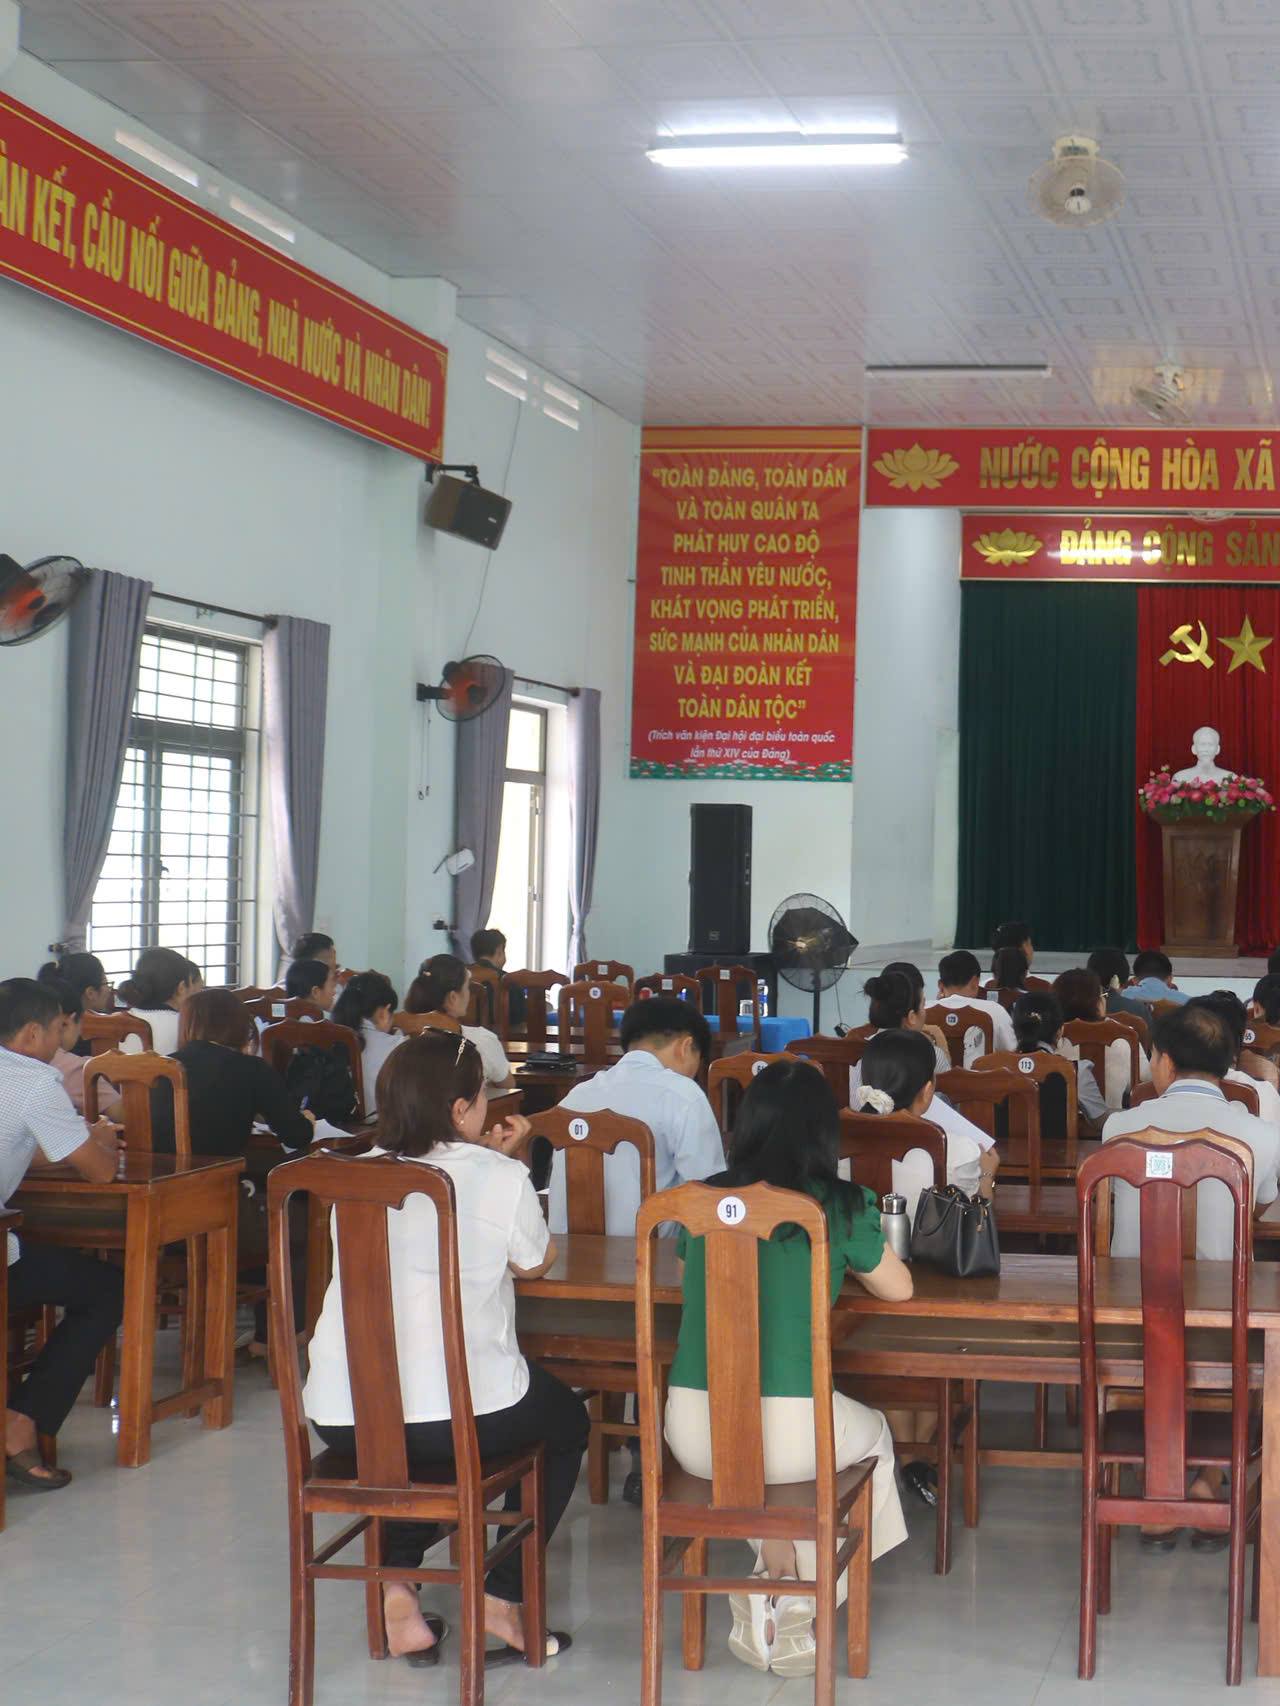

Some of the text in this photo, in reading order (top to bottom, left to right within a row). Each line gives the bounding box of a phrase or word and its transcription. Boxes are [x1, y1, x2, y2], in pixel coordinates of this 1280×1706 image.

[32, 165, 76, 269] KẾT,
[83, 188, 126, 281] CẦU
[128, 216, 165, 302] NỐI
[168, 245, 209, 325] GIỮA
[213, 258, 263, 358] ĐẢNG,
[267, 298, 298, 368] NHÀ
[301, 317, 342, 386] NƯỚC
[344, 331, 361, 397] VÀ
[363, 347, 400, 414] NHÂN
[708, 461, 759, 491] ĐẢNG,
[764, 463, 807, 488] TOÀN
[812, 463, 847, 488] DÂN
[978, 436, 1060, 490] NƯỚC
[1071, 438, 1150, 498] CỘNG
[1161, 438, 1220, 491] HÒA
[1233, 439, 1276, 491] XÃ
[676, 495, 820, 520] VÀ TOÀN QUÂN TA
[674, 528, 820, 560] PHÁT HUY CAO ĐỘ
[1059, 518, 1133, 567] ĐẢNG
[1142, 524, 1213, 571] CỘNG
[1226, 520, 1280, 567] SẢN
[661, 556, 832, 590] TINH THẦN YÊU NƯỚC,
[651, 590, 839, 624] KHÁT VỌNG PHÁT TRIỂN,
[650, 625, 839, 657] SỨC MẠNH CỦA NHÂN DÂN
[674, 658, 812, 690] VÀ ĐẠI ĐOÀN KẾT
[678, 693, 721, 718] TOÀN
[725, 693, 760, 718] DÂN
[725, 1204, 737, 1218] 91
